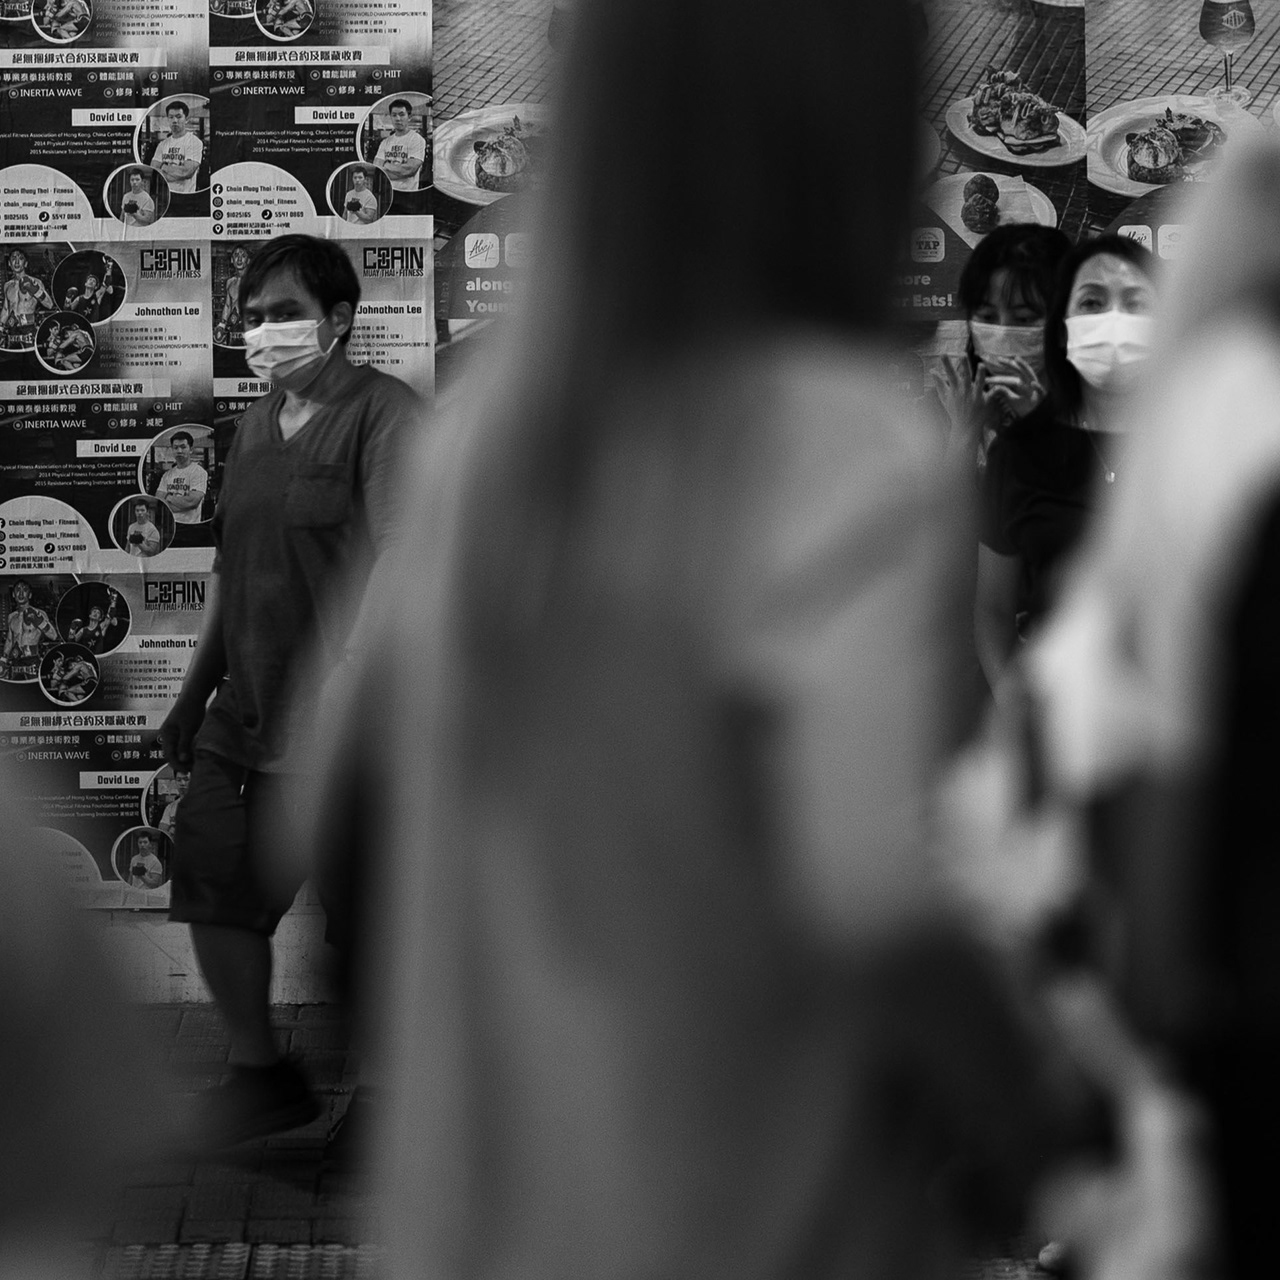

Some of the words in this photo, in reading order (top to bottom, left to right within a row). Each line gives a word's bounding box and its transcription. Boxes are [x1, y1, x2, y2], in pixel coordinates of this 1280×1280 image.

[384, 70, 401, 78] HIIT
[20, 88, 56, 98] INERTIA
[57, 88, 82, 97] WAVE
[90, 112, 113, 122] David
[117, 112, 133, 121] Lee
